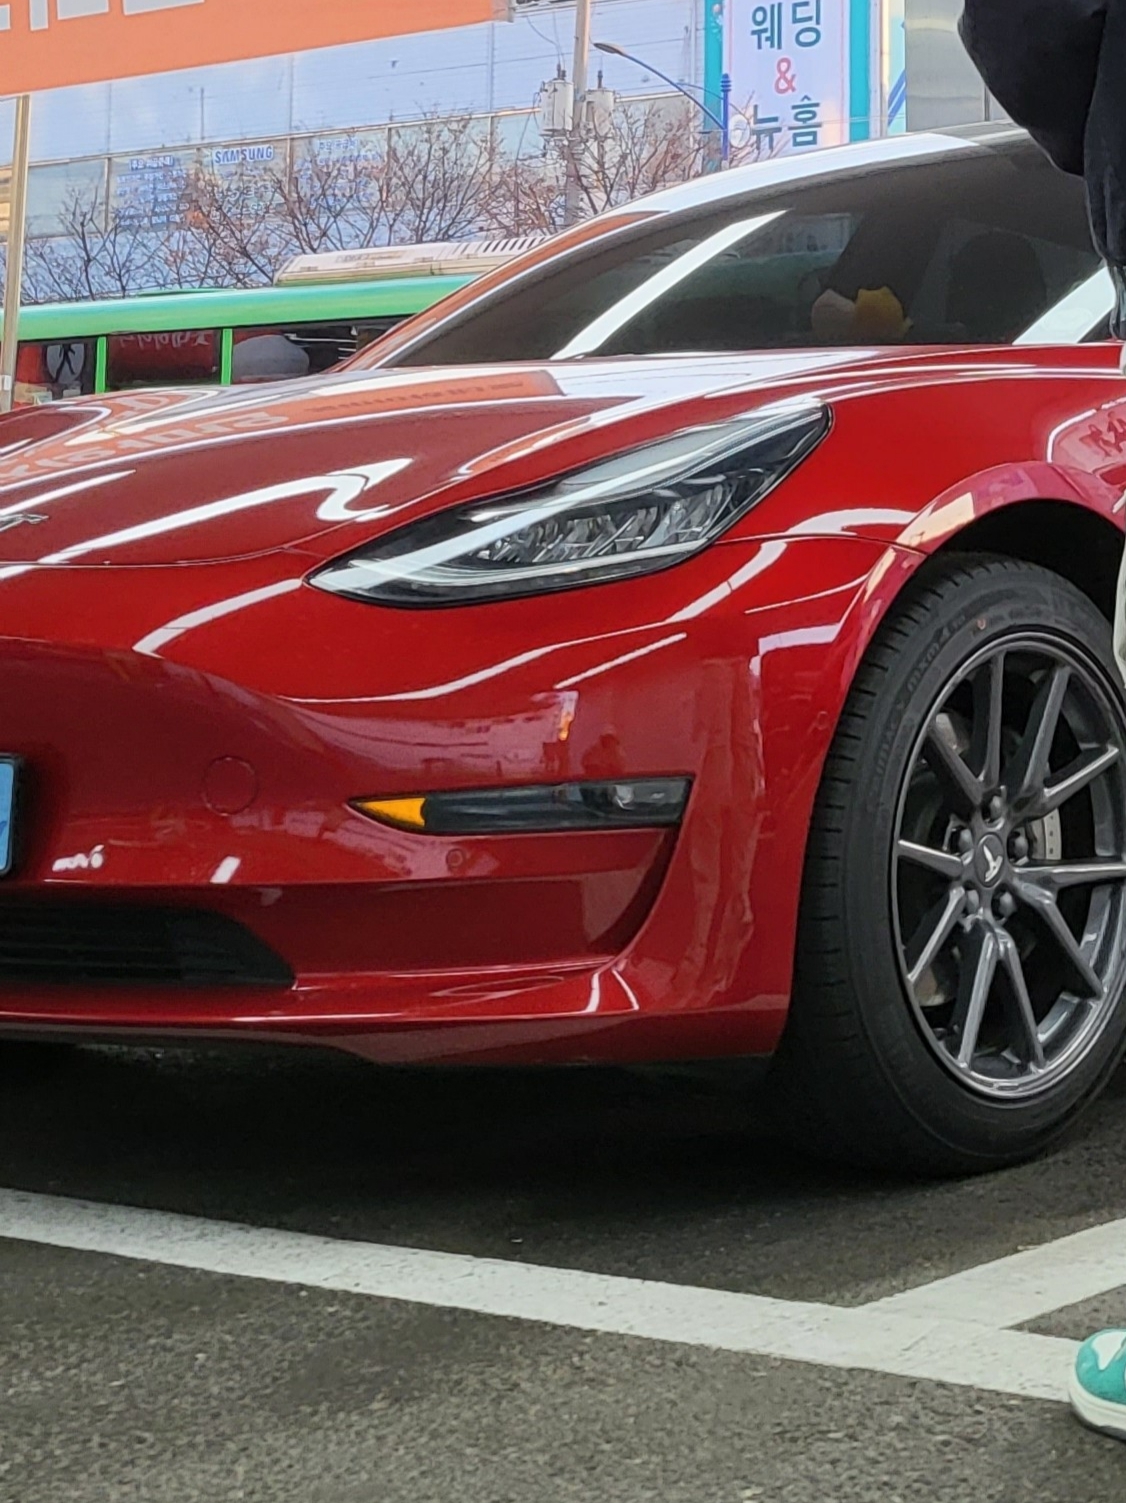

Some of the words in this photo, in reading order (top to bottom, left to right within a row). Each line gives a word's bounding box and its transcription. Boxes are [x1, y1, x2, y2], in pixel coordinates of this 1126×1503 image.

[774, 57, 796, 94] &
[750, 95, 822, 150] 뉴홈
[214, 146, 274, 164] SAMSUNG
